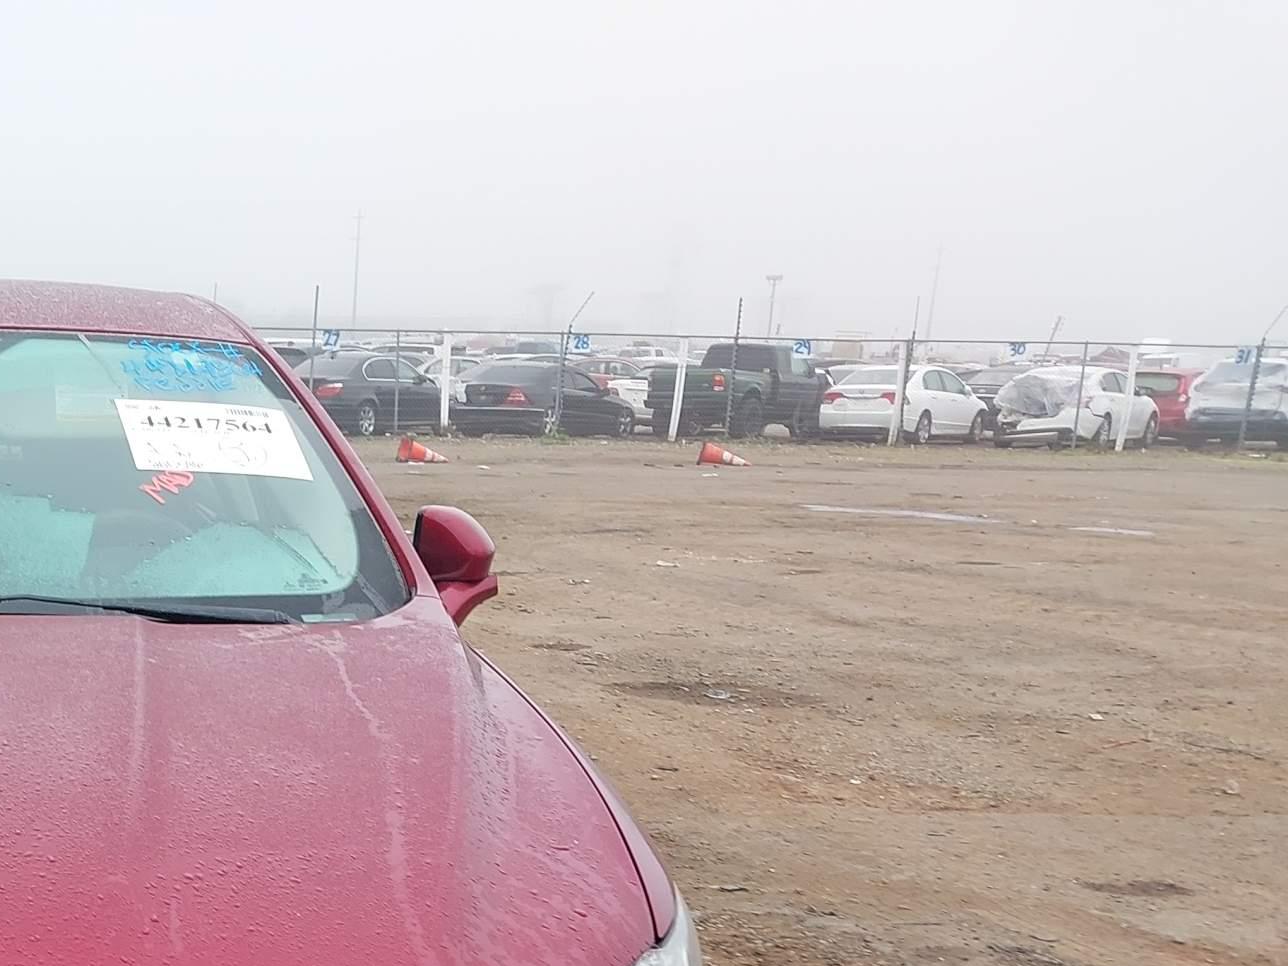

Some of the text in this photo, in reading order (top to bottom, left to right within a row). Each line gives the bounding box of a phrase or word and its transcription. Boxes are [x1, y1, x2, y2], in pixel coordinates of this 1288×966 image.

[322, 330, 340, 346] 27
[574, 335, 590, 349] 28
[1009, 342, 1026, 357] 30
[1235, 349, 1251, 364] 31
[140, 415, 273, 434] 44217564
